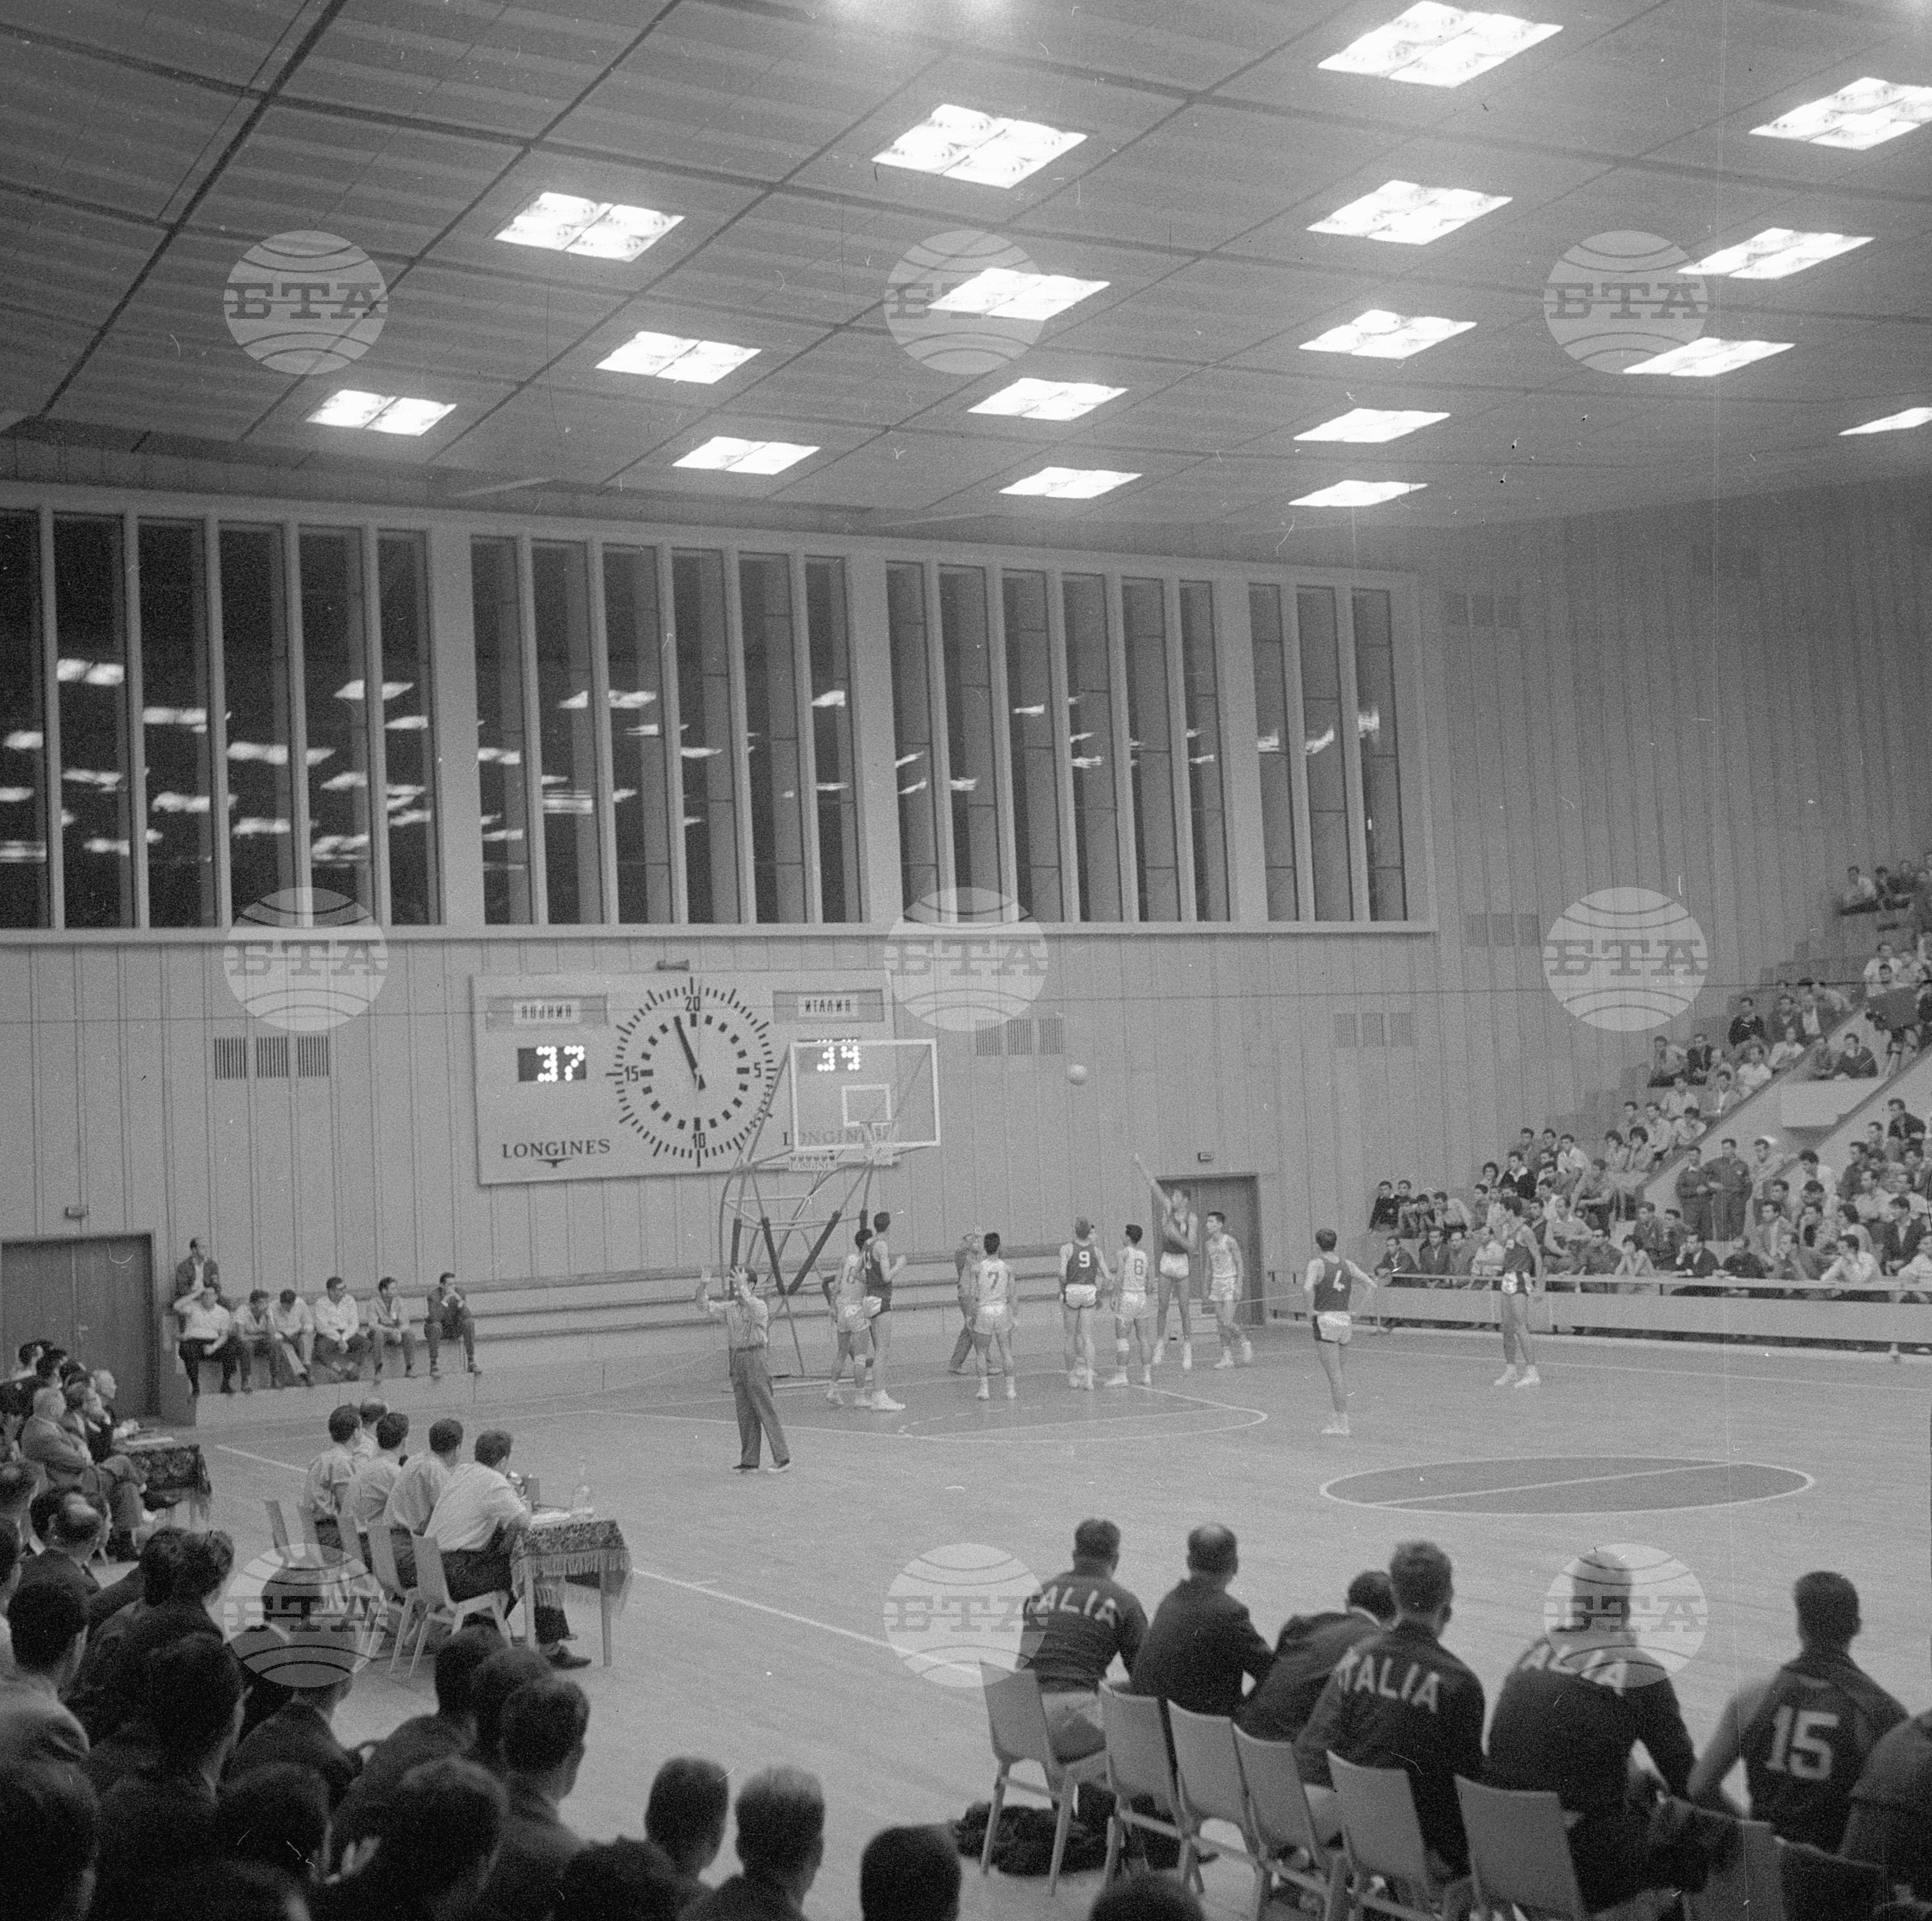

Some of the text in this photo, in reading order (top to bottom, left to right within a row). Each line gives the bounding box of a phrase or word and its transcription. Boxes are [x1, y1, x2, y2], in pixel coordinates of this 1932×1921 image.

[685, 996, 700, 1011] 20
[536, 1045, 585, 1082] 37
[753, 1062, 762, 1078] 5
[625, 1065, 639, 1082] 15
[502, 1139, 611, 1158] LONGINES
[692, 1132, 706, 1148] 10
[1079, 1251, 1090, 1268] 9
[987, 1271, 999, 1289] 7
[1333, 1270, 1345, 1292] 4
[1766, 1705, 1840, 1780] 15
